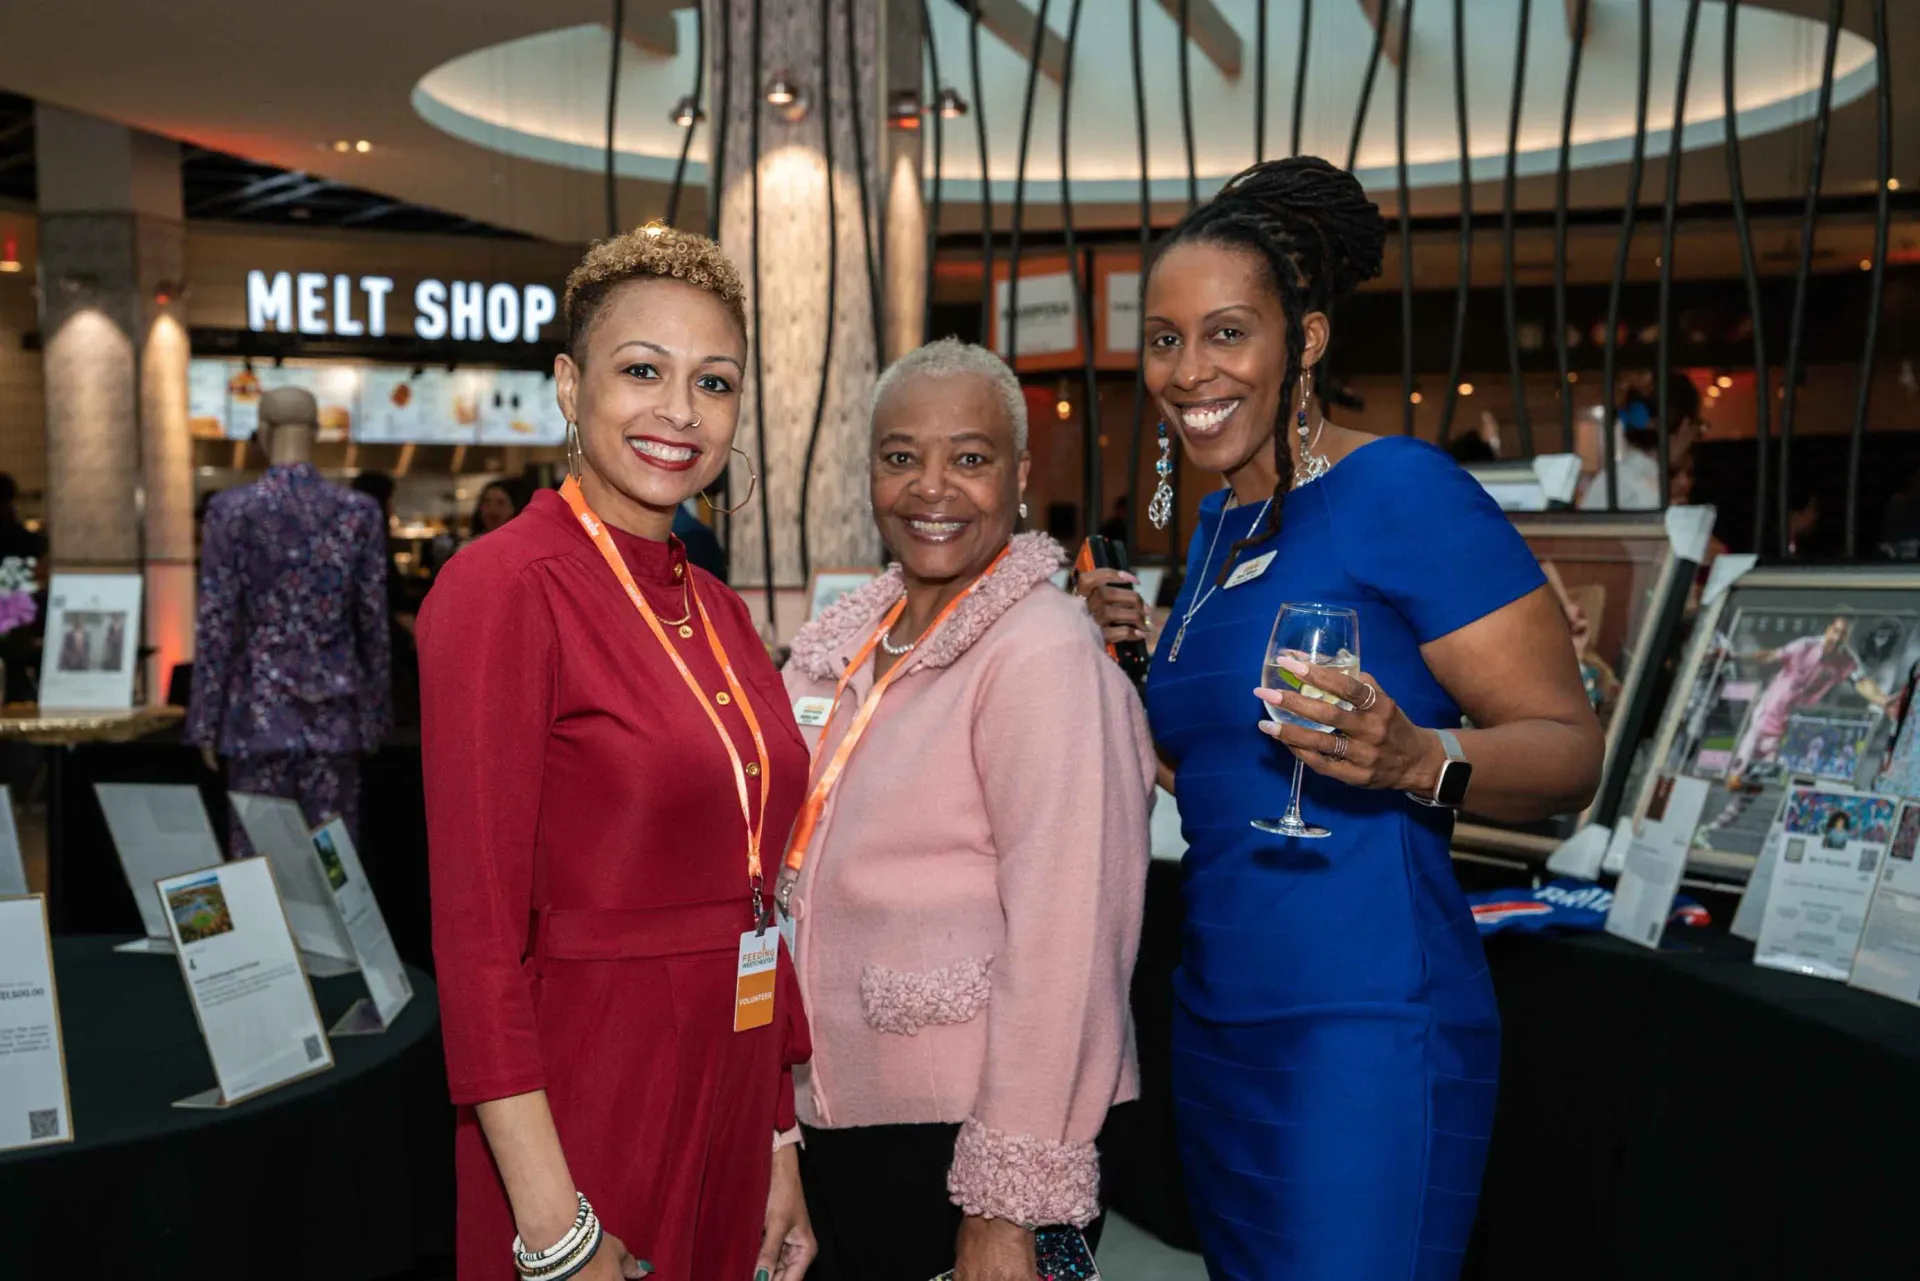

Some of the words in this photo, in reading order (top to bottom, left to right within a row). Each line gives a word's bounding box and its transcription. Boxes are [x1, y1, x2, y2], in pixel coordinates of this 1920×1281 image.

[247, 270, 394, 337] MELT
[414, 278, 556, 343] SHOP
[742, 948, 775, 962] FEEDING
[742, 957, 774, 969] WESTCHESTER
[739, 992, 772, 1005] VOLUNTEER
